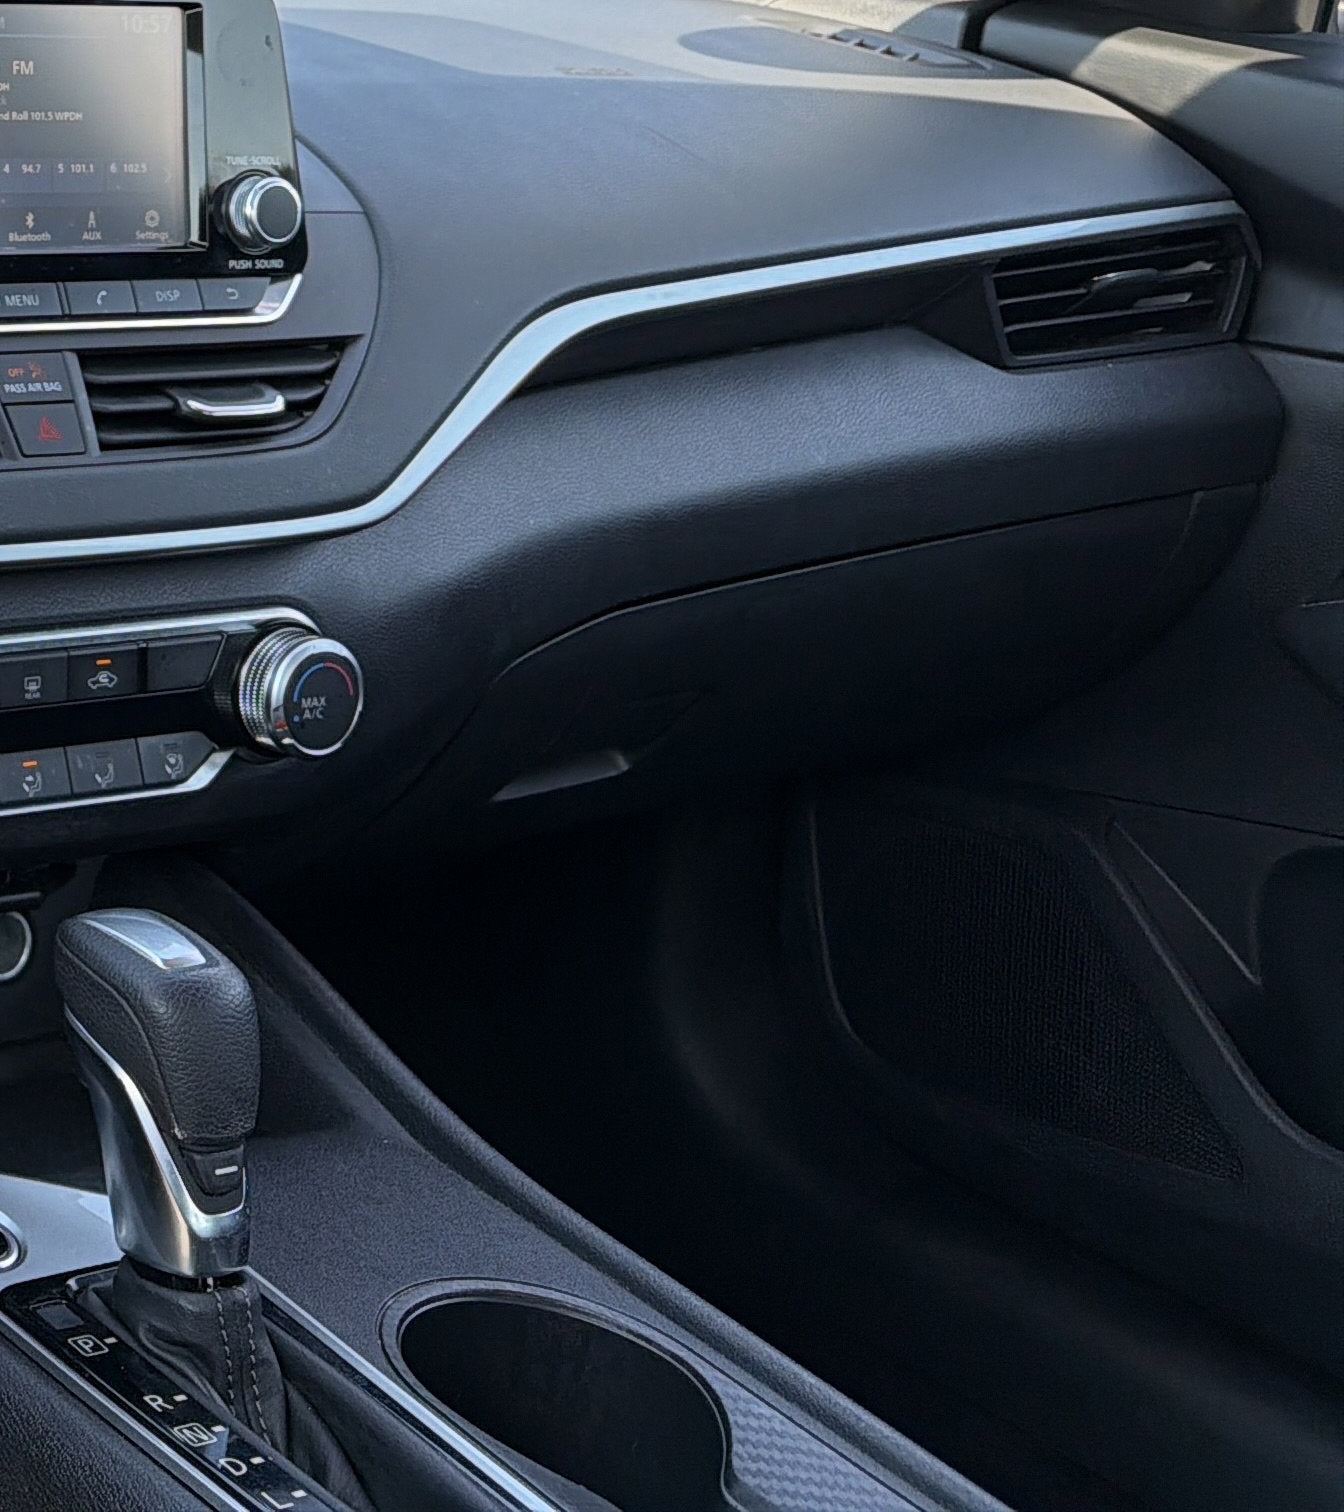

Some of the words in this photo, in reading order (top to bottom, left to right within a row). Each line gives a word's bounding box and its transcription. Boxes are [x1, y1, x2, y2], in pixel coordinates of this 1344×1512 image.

[12, 60, 34, 75] FM
[11, 111, 29, 122] Roll
[31, 111, 54, 122] 101.5
[55, 111, 83, 122] WPDH
[3, 164, 10, 175] 4
[21, 164, 41, 175] 94.7
[58, 164, 64, 175] 5
[70, 164, 94, 175] 101.1
[123, 164, 148, 175] 102.5
[9, 231, 51, 243] Bluetooth
[82, 231, 102, 241] AUX
[135, 230, 169, 242] Settings
[228, 259, 253, 270] PUSH
[254, 259, 284, 270] SOUND
[5, 294, 40, 307] MENU
[155, 290, 180, 303] DISP
[7, 367, 25, 378] OFF
[301, 696, 328, 709] MAX
[302, 707, 325, 721] A/C
[77, 1338, 95, 1353] P
[142, 1394, 175, 1413] R
[182, 1425, 210, 1444] N
[218, 1457, 248, 1476] D
[260, 1491, 295, 1510] L
